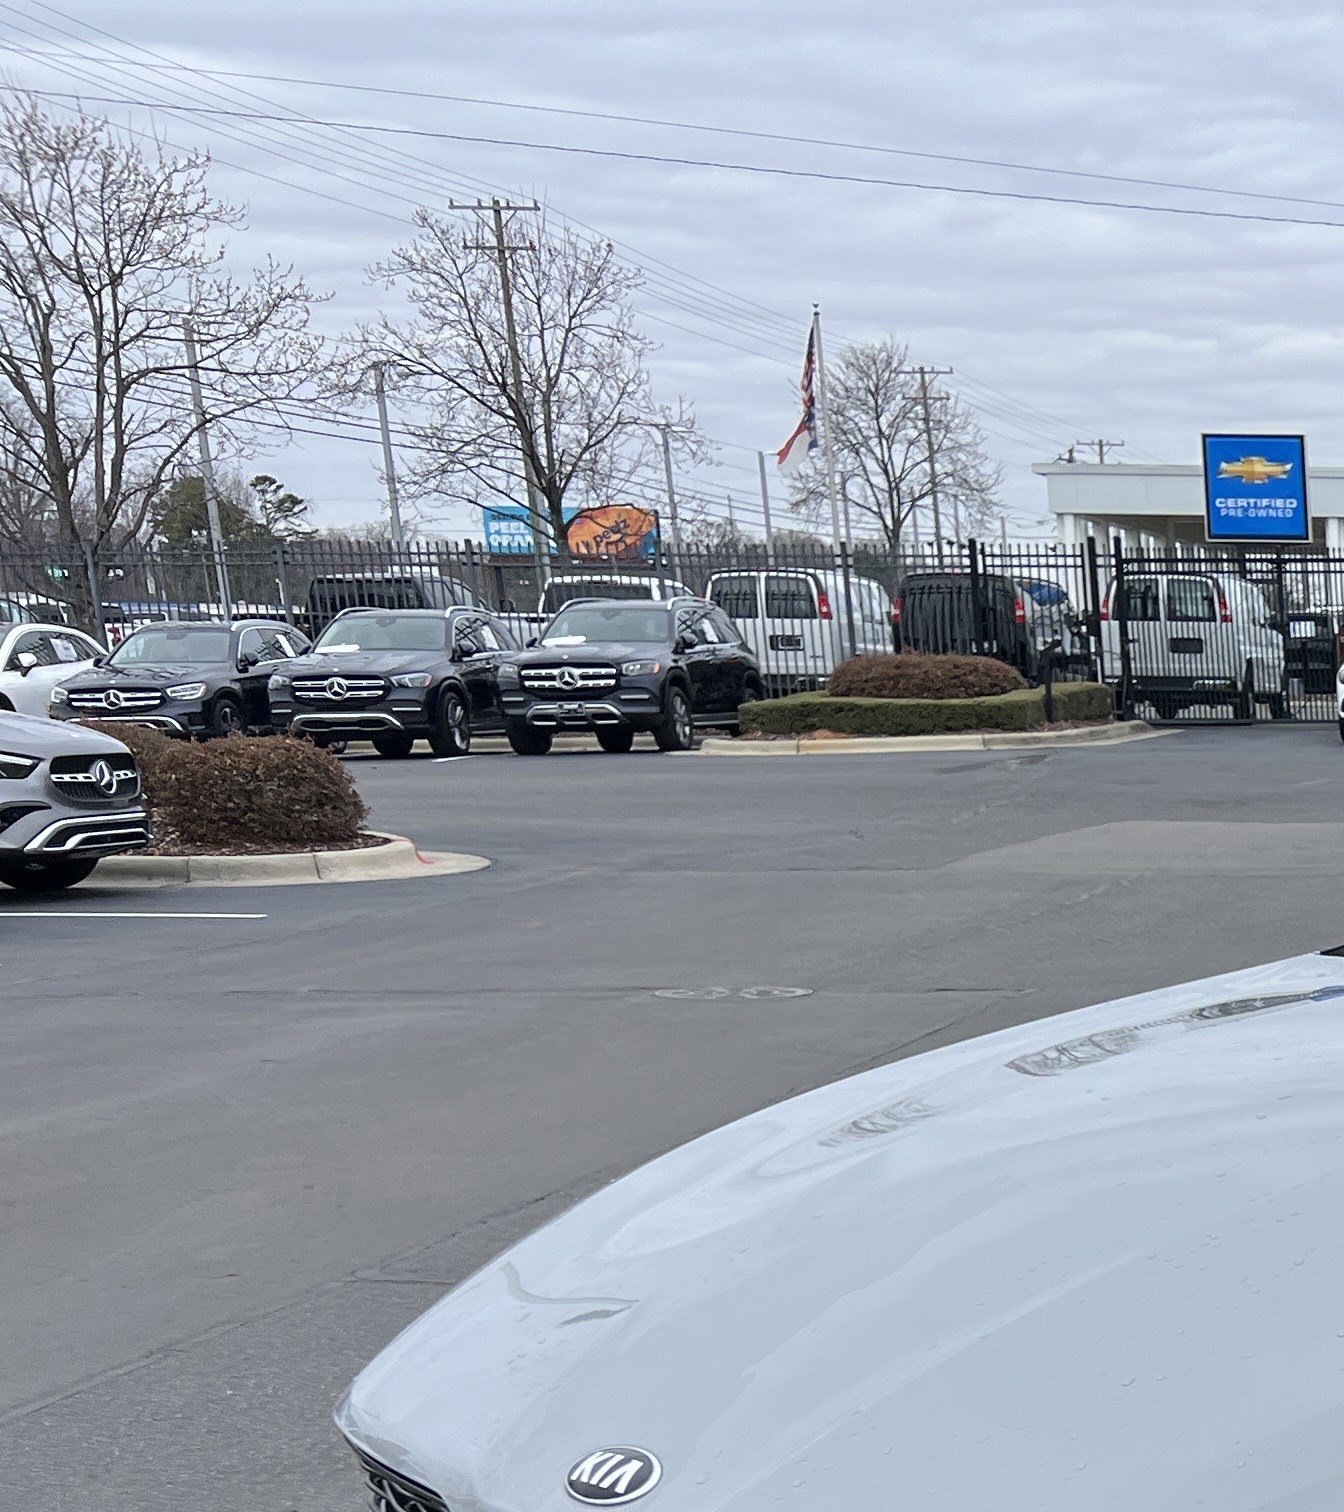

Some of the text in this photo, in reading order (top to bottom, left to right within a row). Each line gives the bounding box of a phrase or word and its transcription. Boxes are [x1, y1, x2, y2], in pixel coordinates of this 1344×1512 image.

[1215, 498, 1298, 508] CERTIFIED
[1220, 509, 1293, 517] PRE-OWNED
[570, 1451, 643, 1494] KIA
